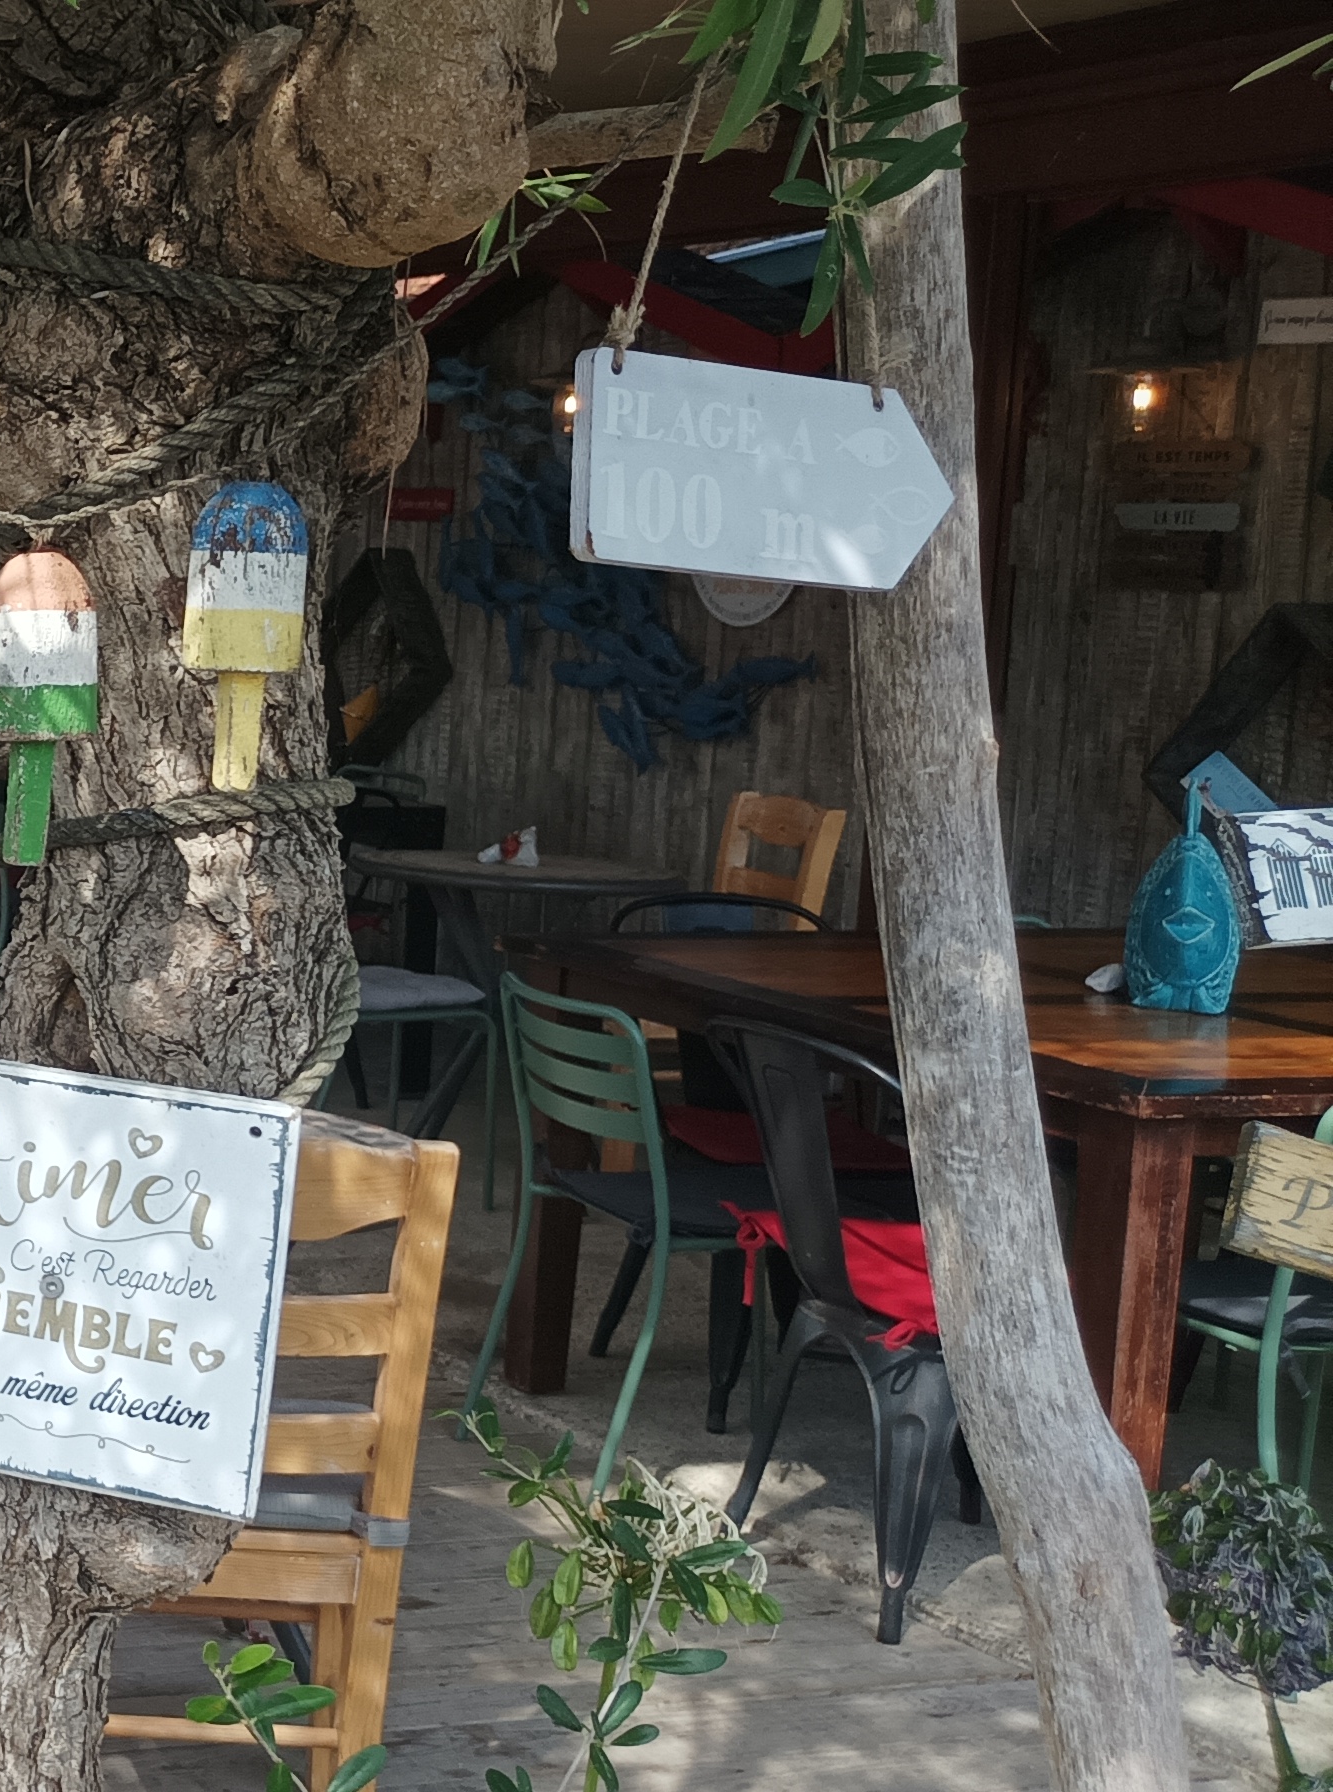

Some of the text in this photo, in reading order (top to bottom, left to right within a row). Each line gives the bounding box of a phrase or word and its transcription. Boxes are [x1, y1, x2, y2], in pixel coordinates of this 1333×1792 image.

[604, 386, 819, 465] PLAGE A
[1155, 450, 1181, 463] EST
[1187, 450, 1231, 463] TEMPS
[600, 462, 816, 562] 100 m
[1174, 510, 1196, 525] VIE
[9, 1238, 217, 1302] C'est Regarder
[2, 1372, 79, 1407] même
[89, 1378, 211, 1430] direction
